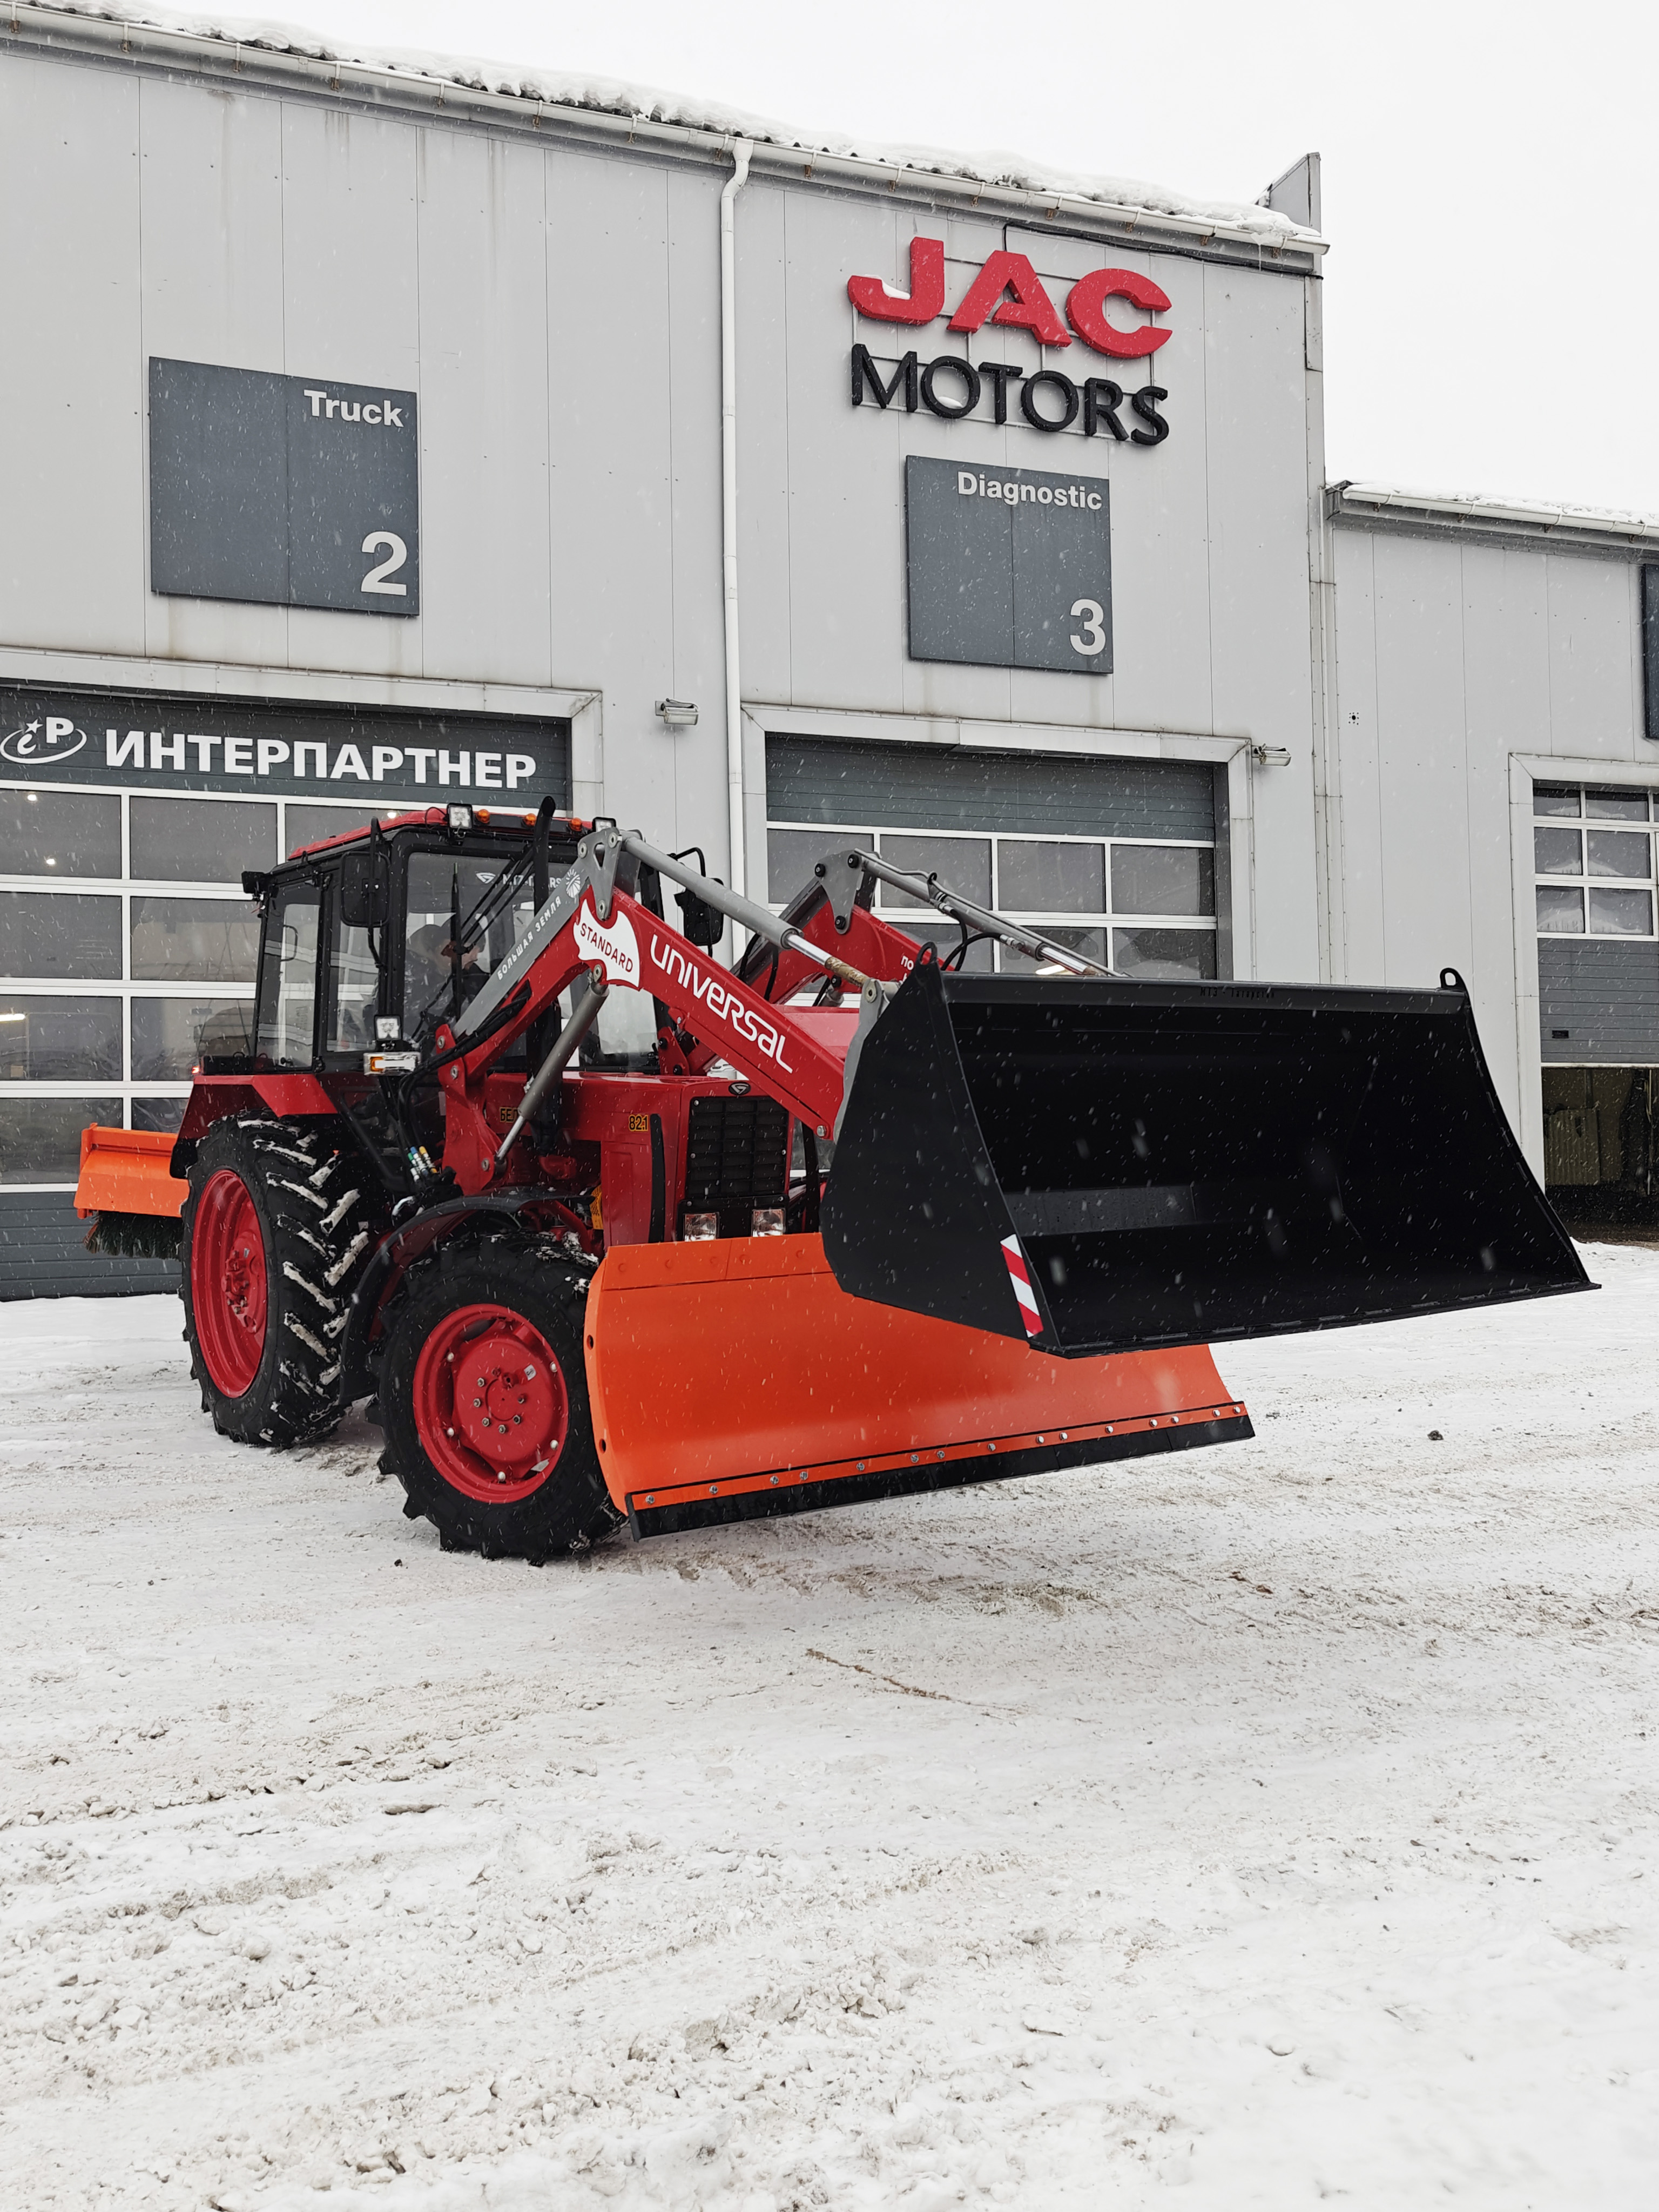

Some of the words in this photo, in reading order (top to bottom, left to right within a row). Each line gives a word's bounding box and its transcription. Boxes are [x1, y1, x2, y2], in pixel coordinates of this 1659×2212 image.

[847, 237, 1172, 359] JAC
[304, 389, 404, 428] Truck
[851, 343, 1169, 445] MOTORS
[957, 471, 1102, 510] Diagnostic
[361, 531, 407, 596] 2
[1069, 599, 1107, 656] 3
[106, 729, 536, 788] ИНТЕРПАРТНЕР
[497, 931, 534, 980] БОЛЬШАЯ
[535, 895, 562, 933] ЗЕМЛЯ
[580, 923, 633, 973] STANDARD
[629, 1115, 649, 1131] 82.1
